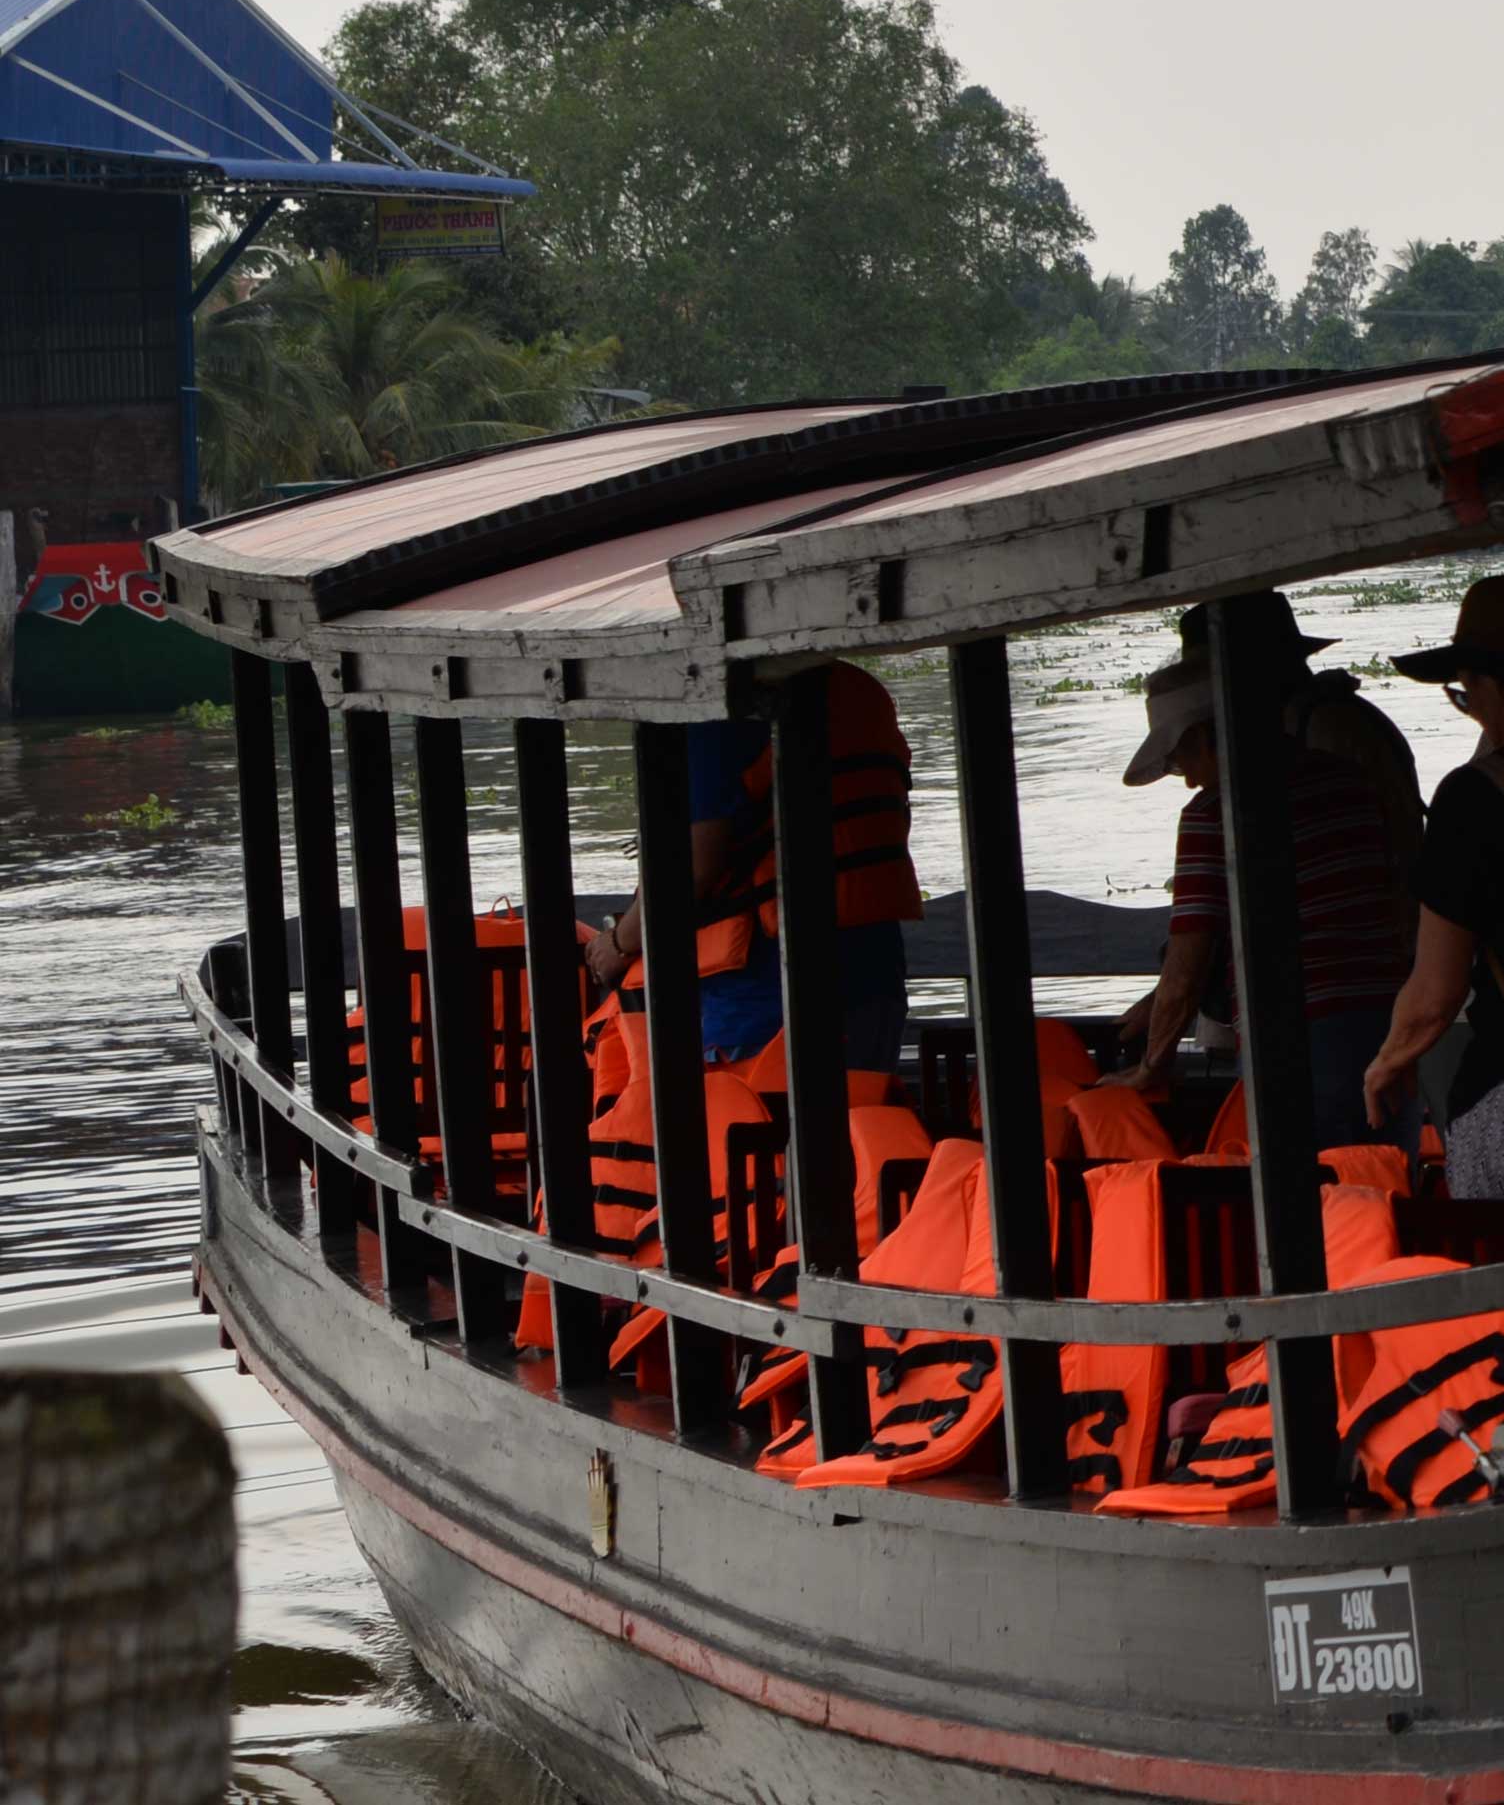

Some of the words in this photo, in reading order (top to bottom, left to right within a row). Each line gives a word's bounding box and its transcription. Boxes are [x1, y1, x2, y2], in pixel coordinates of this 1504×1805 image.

[1341, 1589, 1376, 1631] 49K
[1272, 1603, 1312, 1692] ĐT
[1315, 1642, 1416, 1694] 23800
